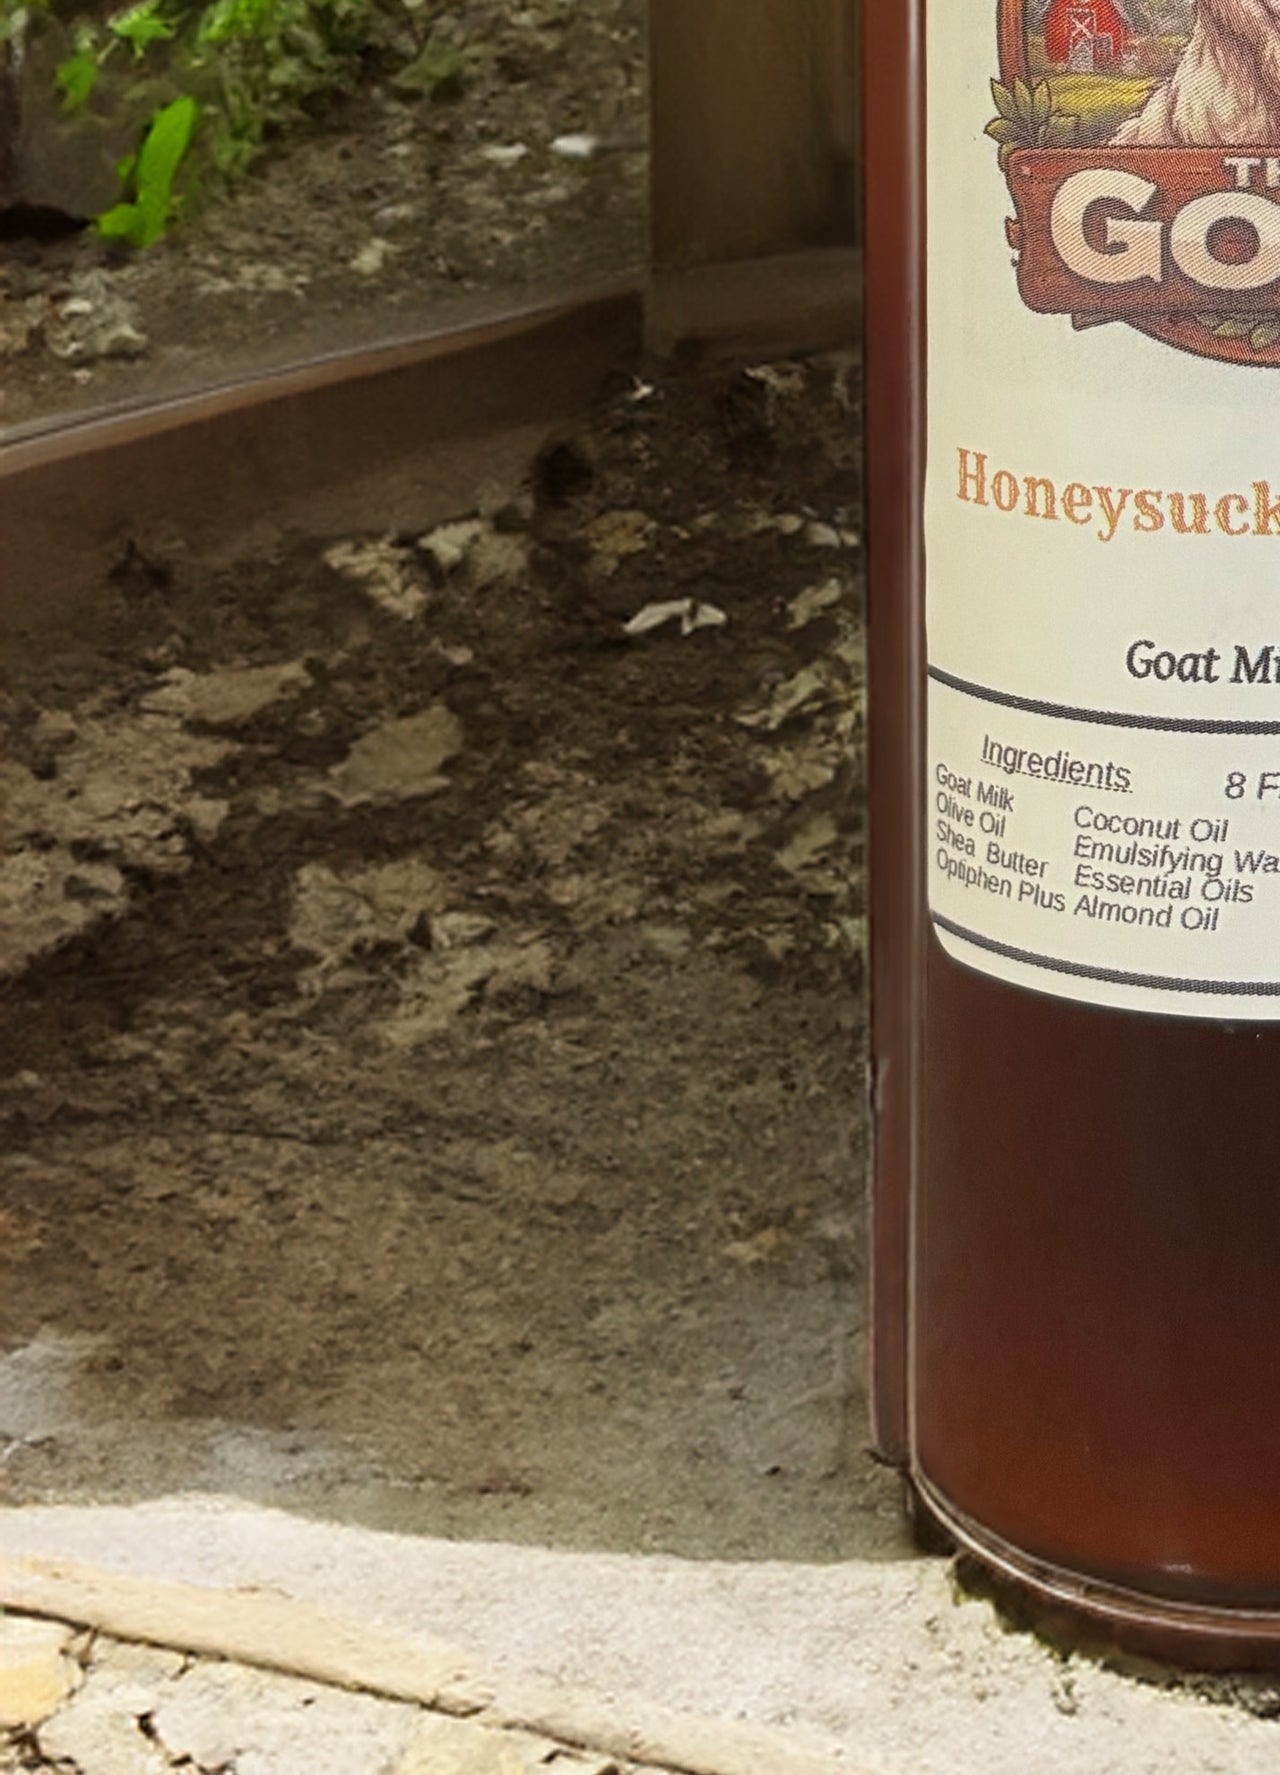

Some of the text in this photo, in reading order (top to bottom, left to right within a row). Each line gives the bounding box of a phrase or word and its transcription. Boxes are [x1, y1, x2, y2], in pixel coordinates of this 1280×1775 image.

[1126, 638, 1221, 684] Goat
[980, 734, 1134, 793] Ingredients
[1224, 771, 1247, 800] 8
[935, 763, 1015, 813] Goat Milk
[936, 792, 1006, 838] Olive Oil
[1074, 805, 1229, 843] Coconut Oil
[936, 823, 1050, 878] Shea Butter
[1074, 835, 1224, 877] Emulsifying
[936, 848, 1066, 912] Optiphen Plus
[1074, 865, 1254, 903] Essential Oils
[1074, 894, 1220, 932] Almond Oil
